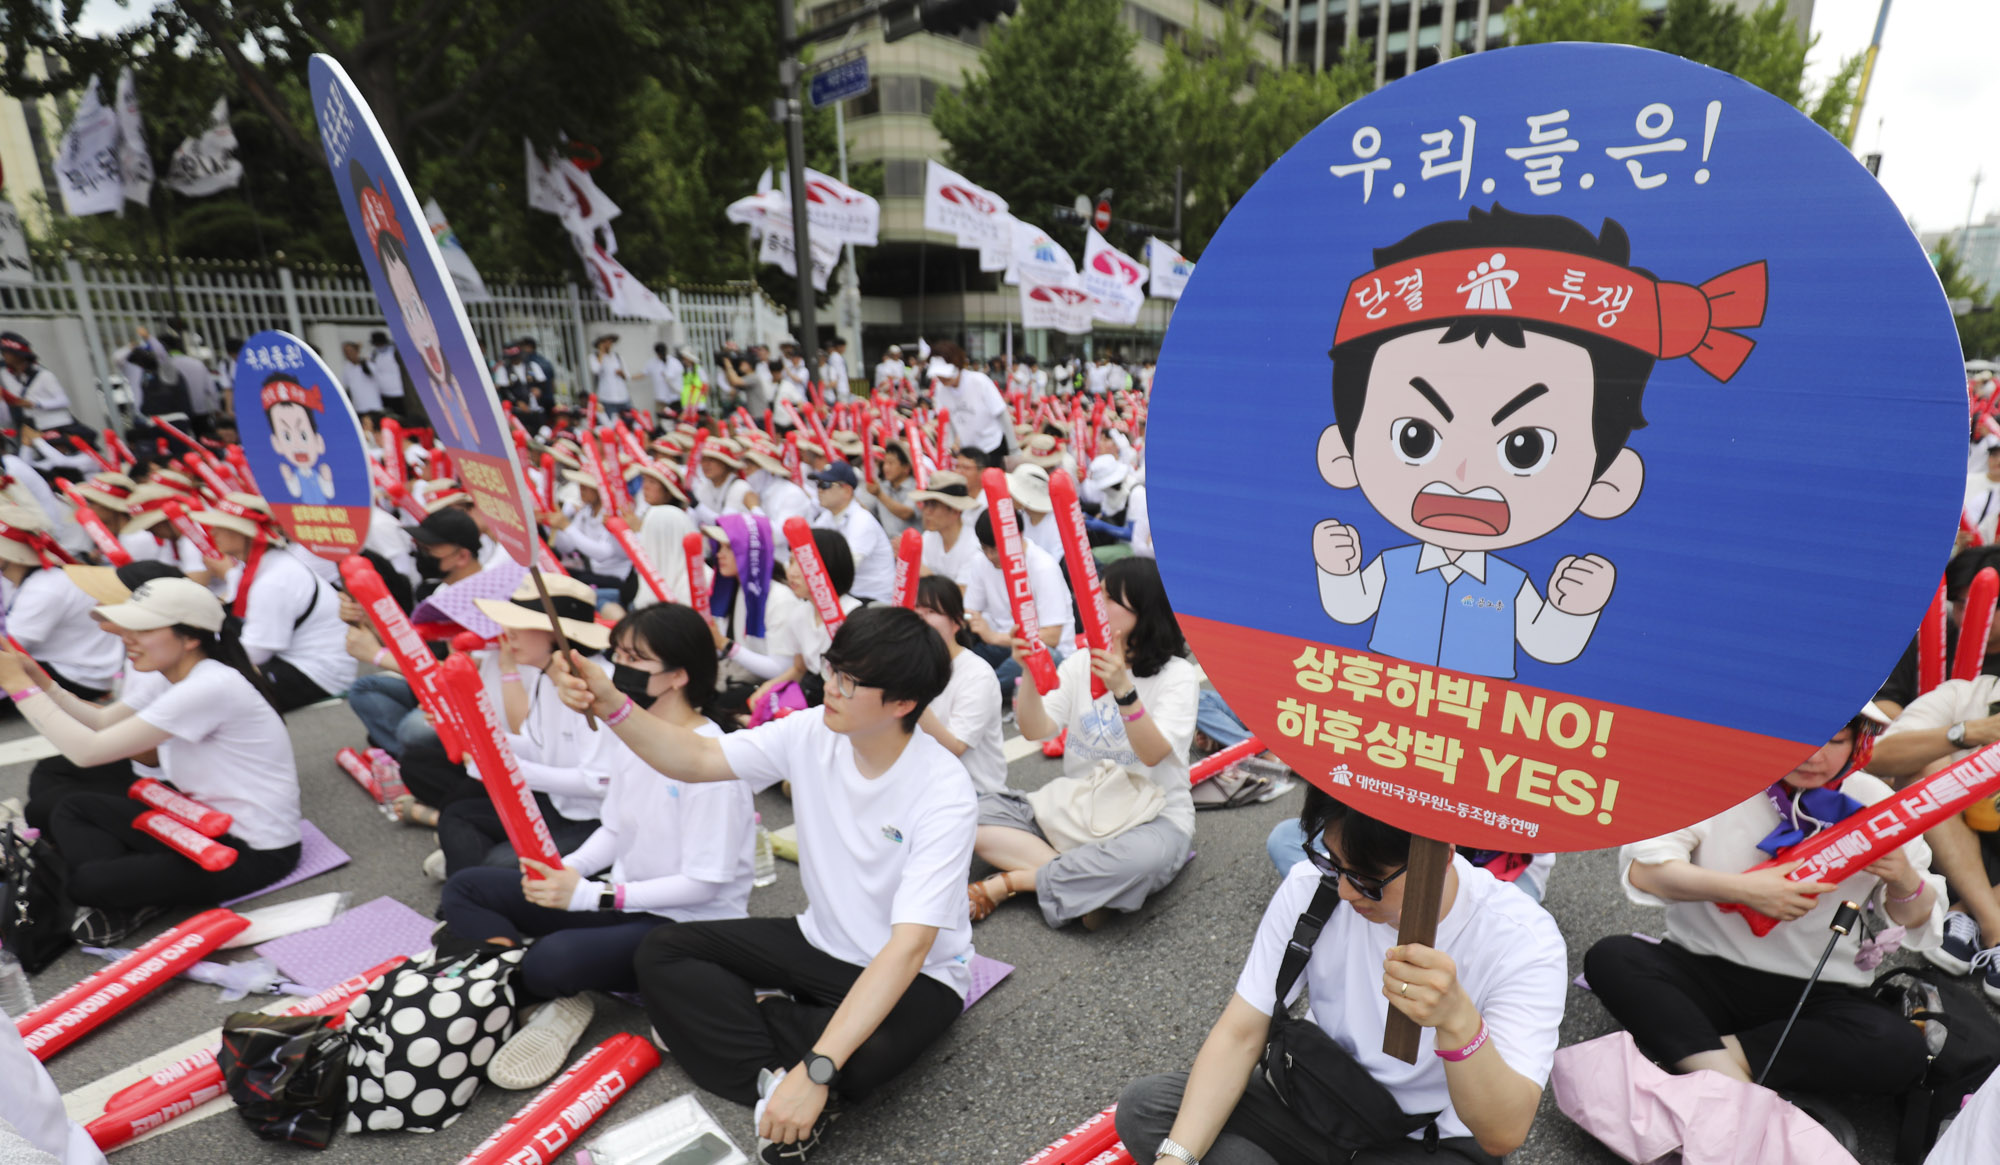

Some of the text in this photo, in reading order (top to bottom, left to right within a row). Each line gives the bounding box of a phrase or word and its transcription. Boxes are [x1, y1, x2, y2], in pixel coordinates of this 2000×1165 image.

[1355, 268, 1632, 328] 단결 투쟁
[997, 498, 1026, 575] 월급빼고
[1293, 646, 1615, 758] 상후하박 NO!
[1276, 697, 1620, 825] 하후상박 YES!
[1356, 774, 1540, 838] 대한민국공무원노동조합총연맹
[1867, 809, 1906, 840] 다
